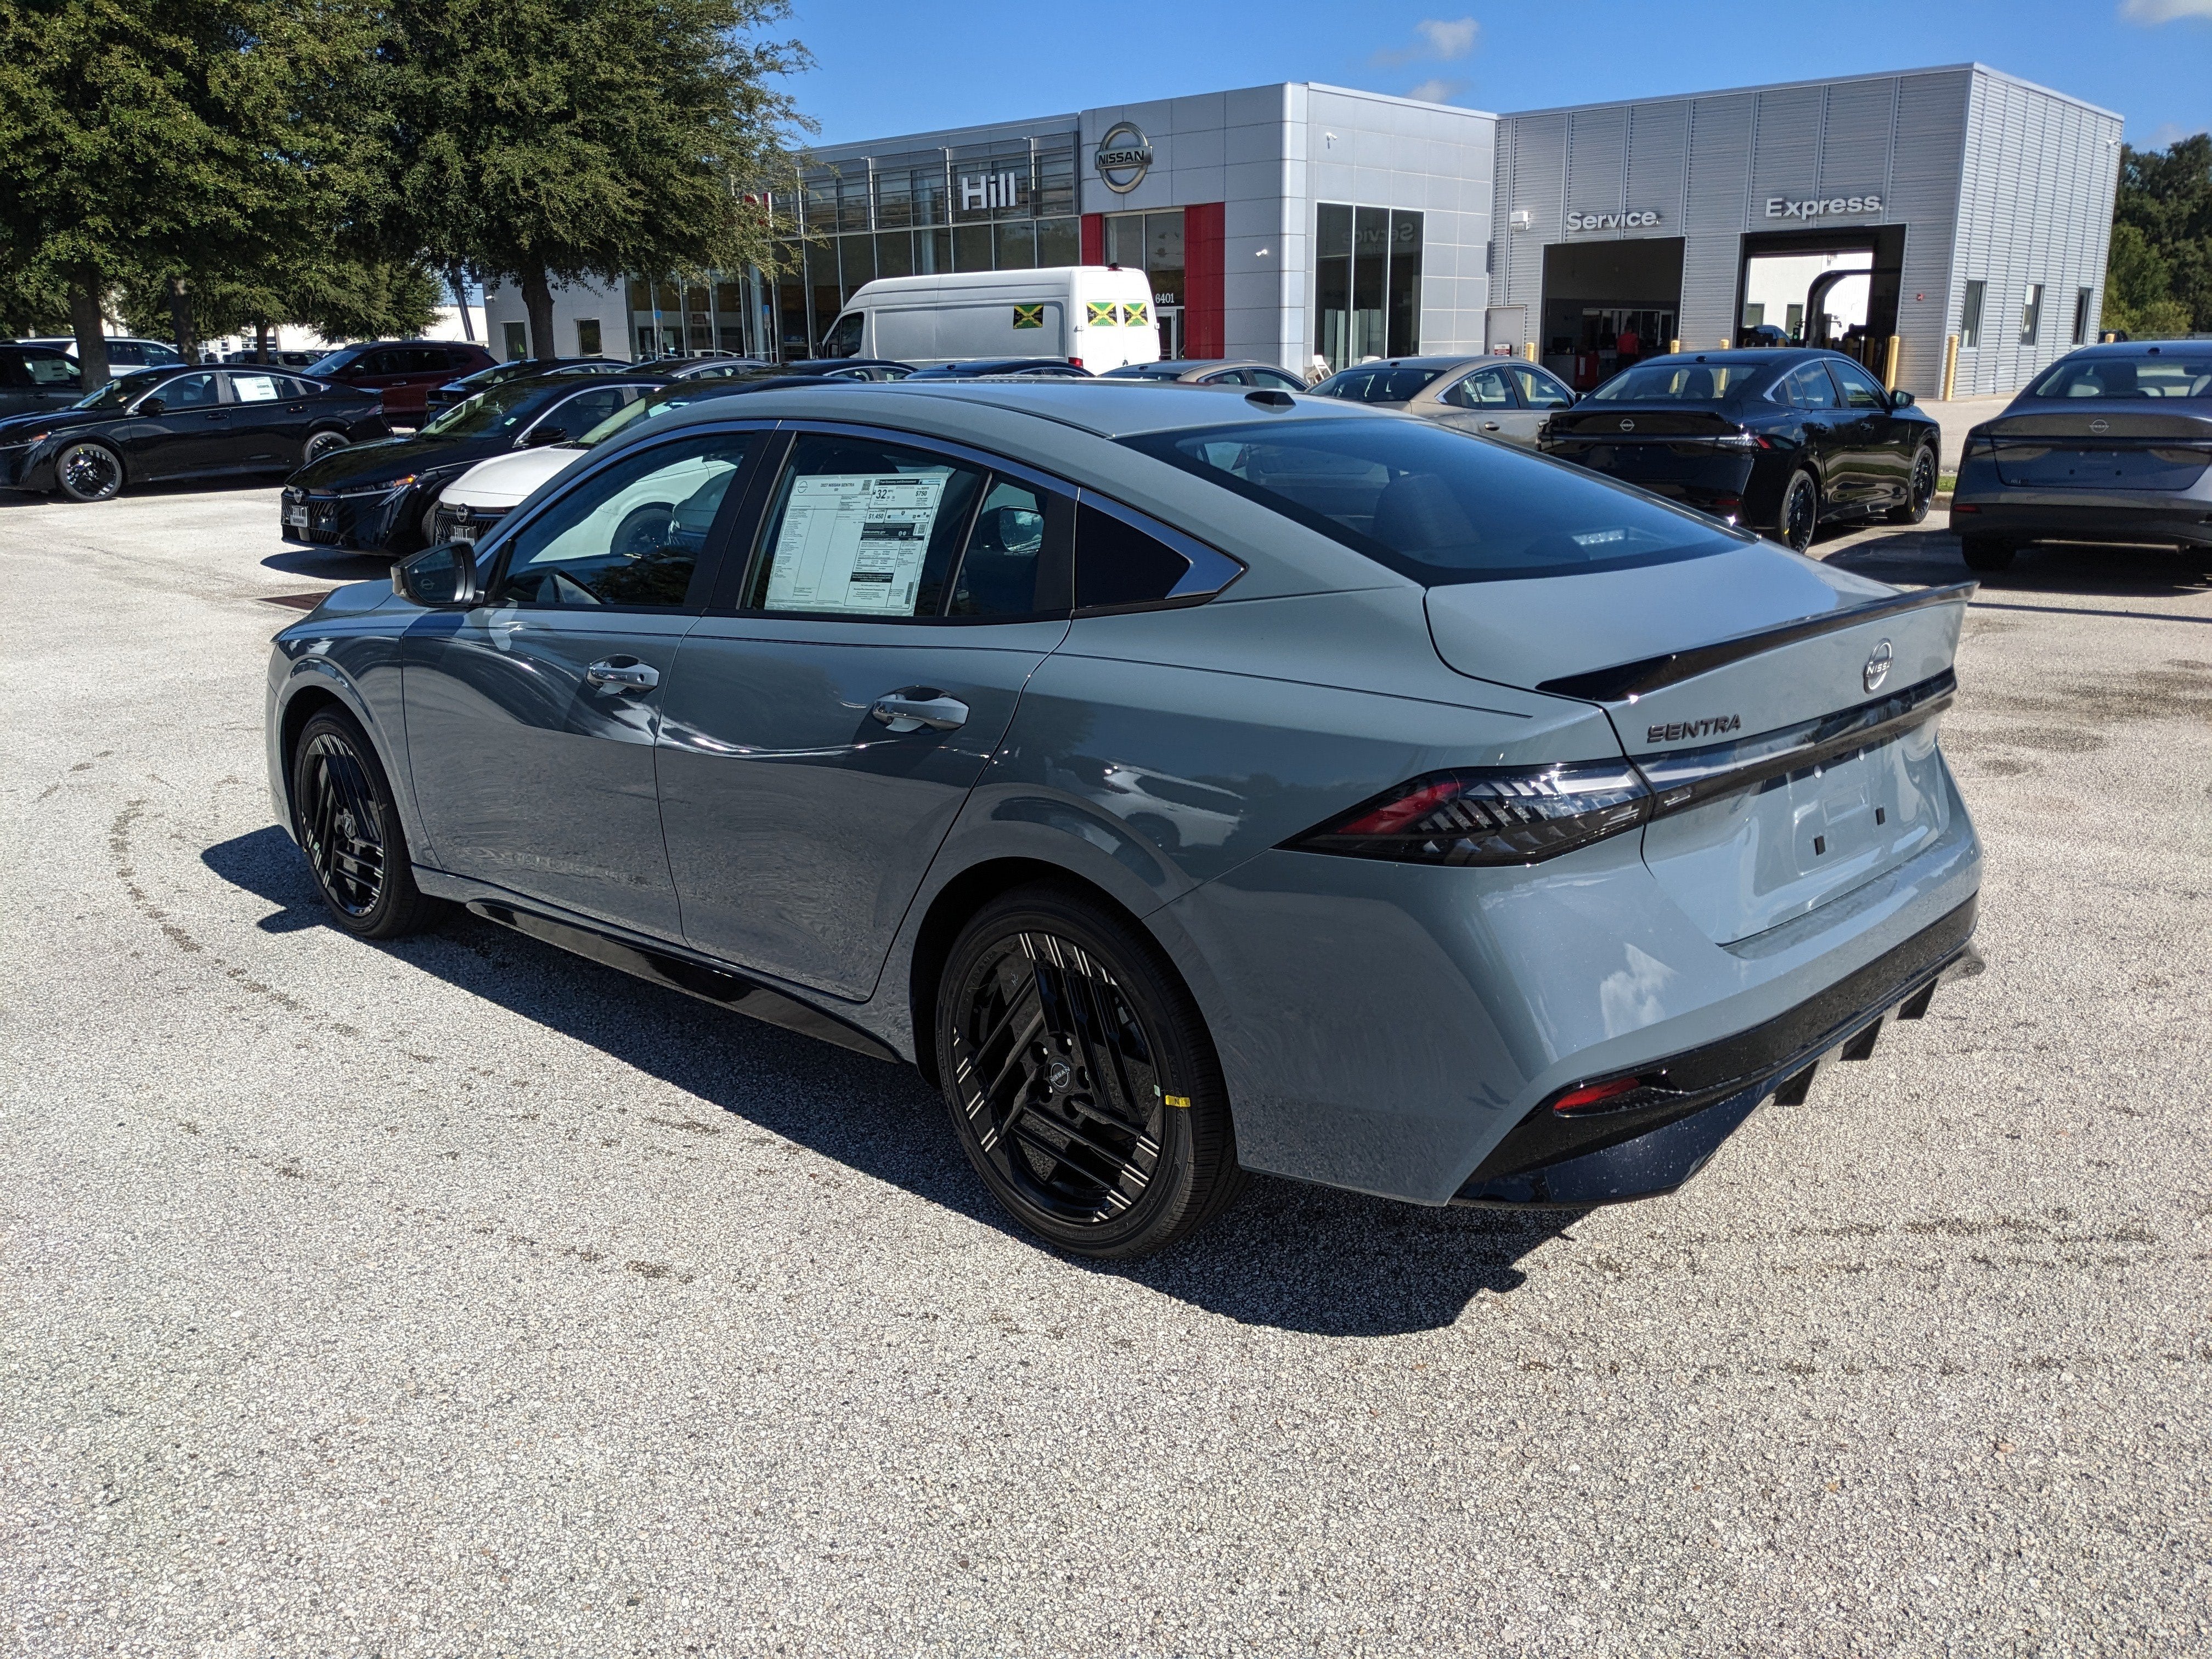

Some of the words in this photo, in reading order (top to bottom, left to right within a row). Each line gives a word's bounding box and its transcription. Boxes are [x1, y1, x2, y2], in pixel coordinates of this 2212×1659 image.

[1098, 150, 1144, 165] NISSAN
[962, 172, 1016, 211] Hill
[1765, 196, 1881, 220] Express
[1566, 210, 1657, 230] Service
[1155, 292, 1175, 304] 6401
[876, 489, 887, 499] 32
[454, 528, 470, 540] HILL
[1646, 714, 1741, 743] SENTRA
[1049, 1066, 1071, 1083] NISSAN
